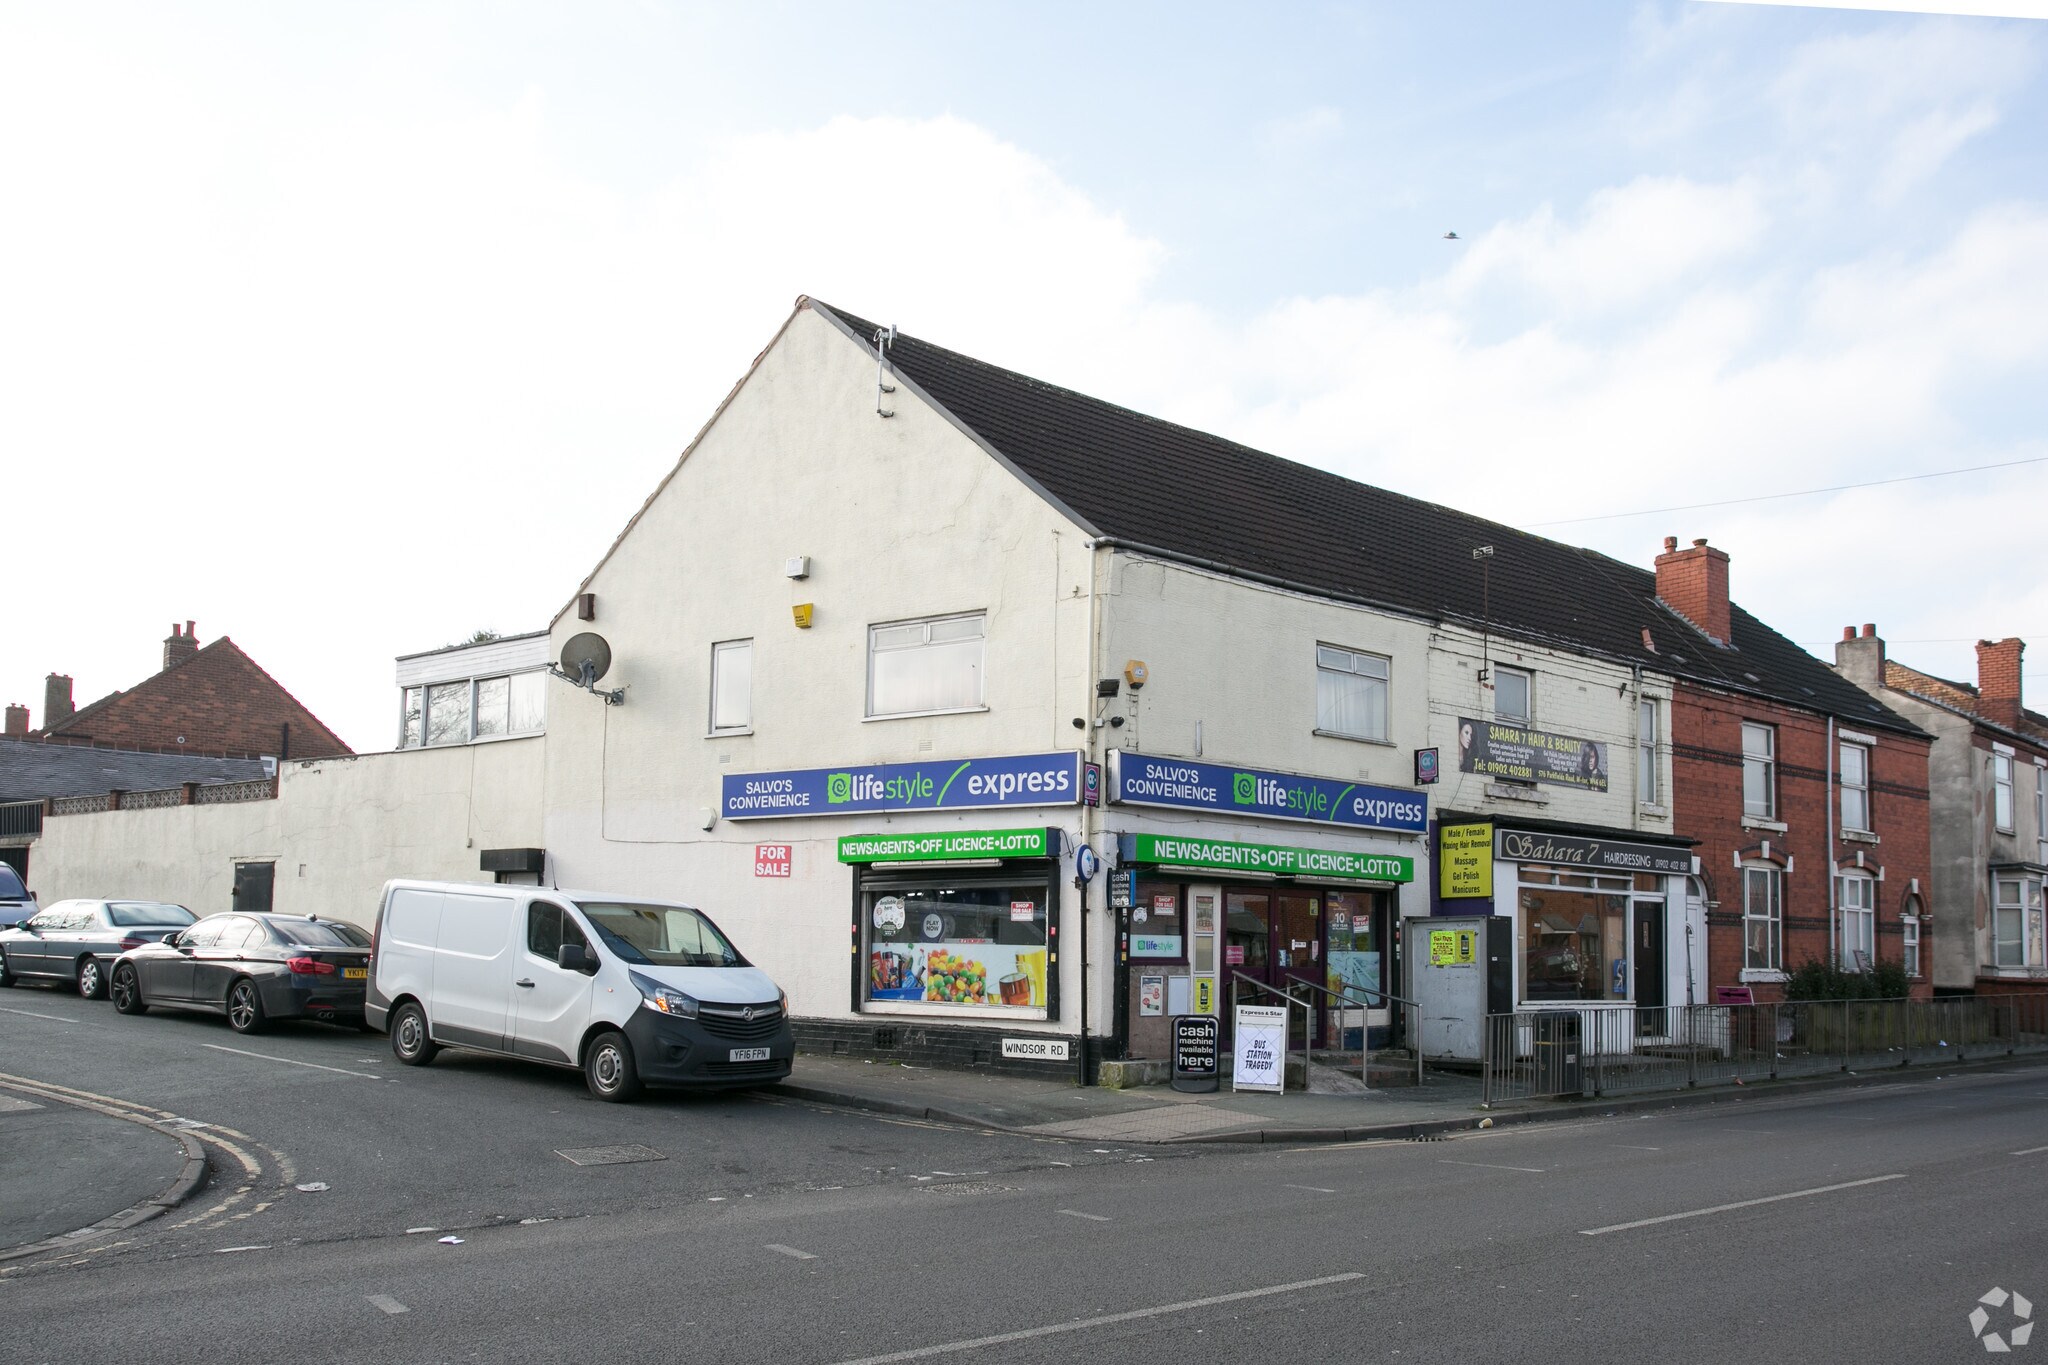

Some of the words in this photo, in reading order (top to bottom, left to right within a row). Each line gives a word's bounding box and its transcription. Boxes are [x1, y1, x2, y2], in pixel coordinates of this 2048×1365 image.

[1489, 726, 1520, 744] SAHARA
[1522, 732, 1526, 744] 7
[1528, 734, 1546, 748] HAIR
[1548, 736, 1554, 749] &
[1555, 738, 1582, 754] BEAUTY
[1146, 764, 1199, 784] SALVO'S
[1474, 758, 1486, 772] Tel:
[1488, 762, 1508, 774] 01902
[1510, 764, 1532, 778] 402881
[746, 780, 793, 794] SALVO'S
[852, 772, 934, 804] lifestyle
[968, 770, 1069, 800] express
[1126, 778, 1216, 802] CONVENIENCE
[729, 793, 810, 810] CONVENIENCE
[1257, 778, 1327, 816] lifestyle
[1353, 797, 1422, 824] express
[1448, 829, 1461, 838] Male
[1466, 828, 1486, 836] Female
[1460, 840, 1470, 848] Hair
[1470, 838, 1492, 848] Removal
[760, 846, 786, 860] FOR
[1505, 834, 1584, 862] Sahara
[1587, 843, 1600, 864] 7
[1604, 852, 1650, 868] HAIRDRESSING
[1655, 860, 1668, 869] 01902
[1670, 862, 1679, 870] 402
[1680, 862, 1688, 871] 881
[1454, 857, 1478, 866] Massage
[756, 862, 789, 876] SALE
[1112, 872, 1130, 882] cash
[1452, 872, 1462, 880] Gel
[1462, 872, 1480, 880] Polish
[1452, 885, 1480, 894] Manicures
[1112, 895, 1130, 906] here
[1334, 912, 1344, 924] 10
[1146, 940, 1174, 952] lifestyle
[348, 969, 364, 977] YK17
[1179, 1025, 1214, 1037] cash
[1179, 1037, 1214, 1045] machine
[1254, 1040, 1266, 1049] BUS
[734, 1050, 751, 1060] YF16
[752, 1048, 766, 1058] FPN
[1005, 1042, 1046, 1054] WINDSOR
[1050, 1045, 1066, 1056] RD.
[1246, 1050, 1272, 1060] STATION
[1179, 1054, 1214, 1066] here
[1246, 1060, 1273, 1070] TRAGEDY
